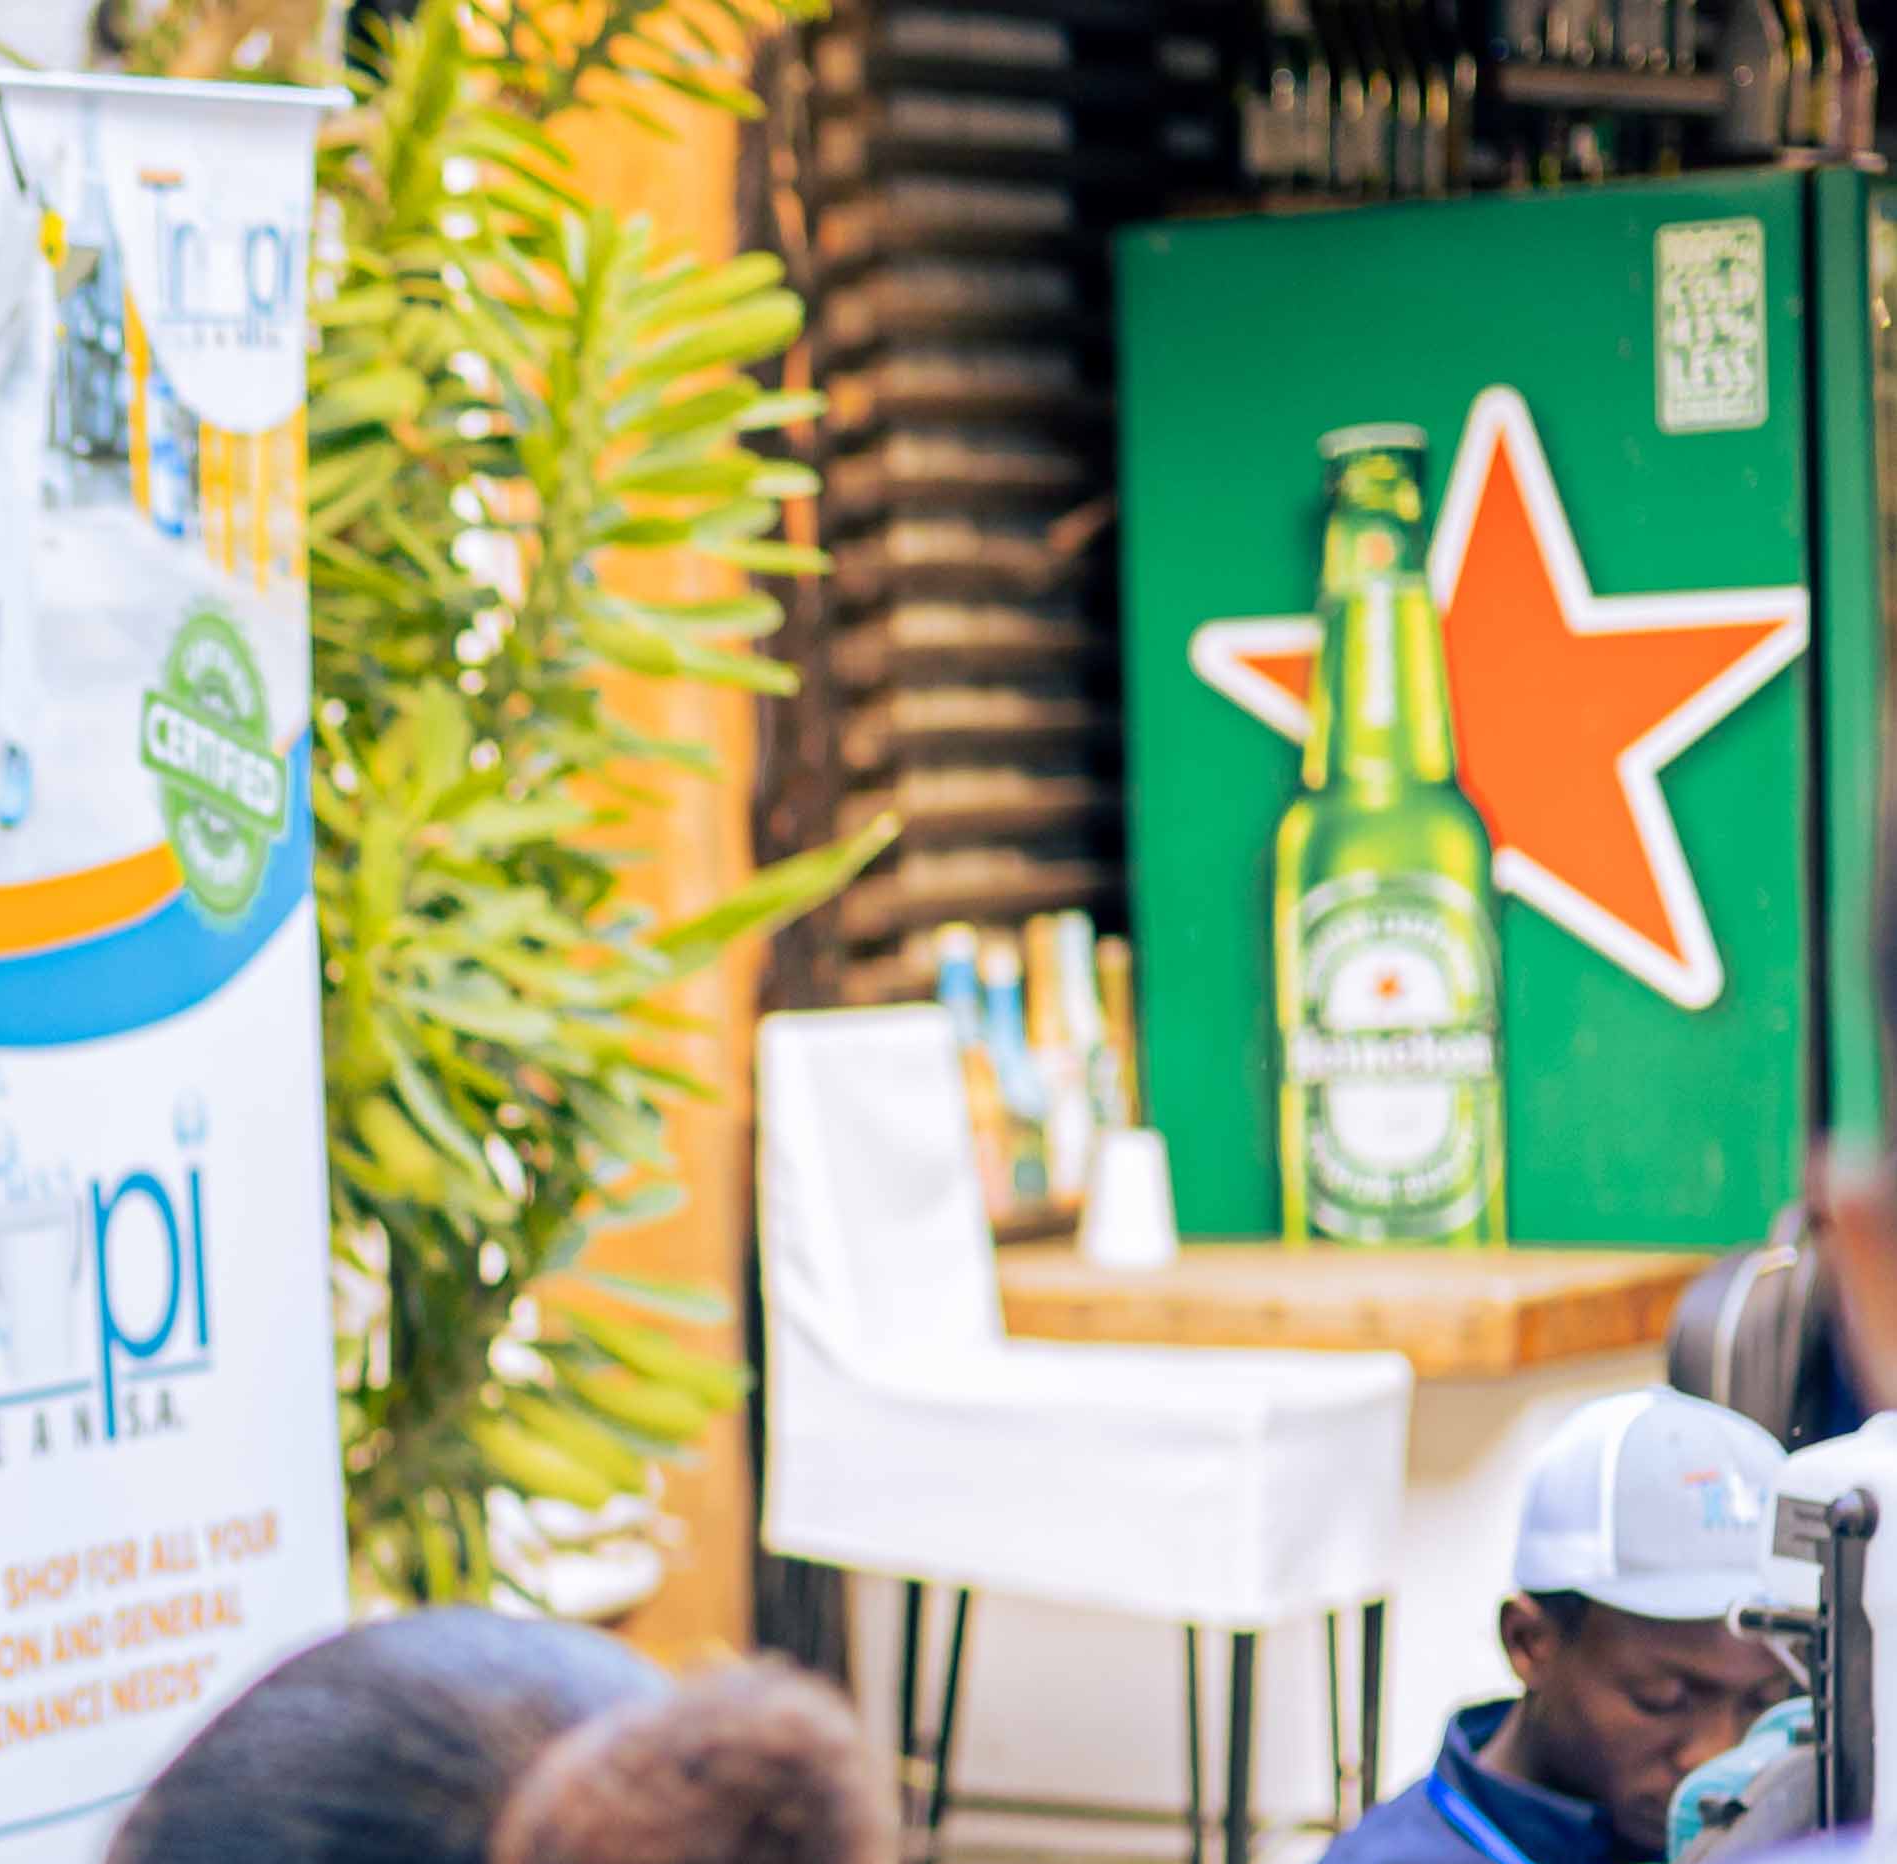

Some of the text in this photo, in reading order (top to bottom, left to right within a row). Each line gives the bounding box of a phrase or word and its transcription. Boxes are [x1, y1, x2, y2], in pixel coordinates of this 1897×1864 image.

[5, 1551, 80, 1610] SHOP
[90, 1537, 139, 1586] FOR
[149, 1530, 198, 1576] ALL
[208, 1509, 280, 1562] YOUR
[53, 1615, 104, 1664] AND
[115, 1584, 244, 1651] GENERAL
